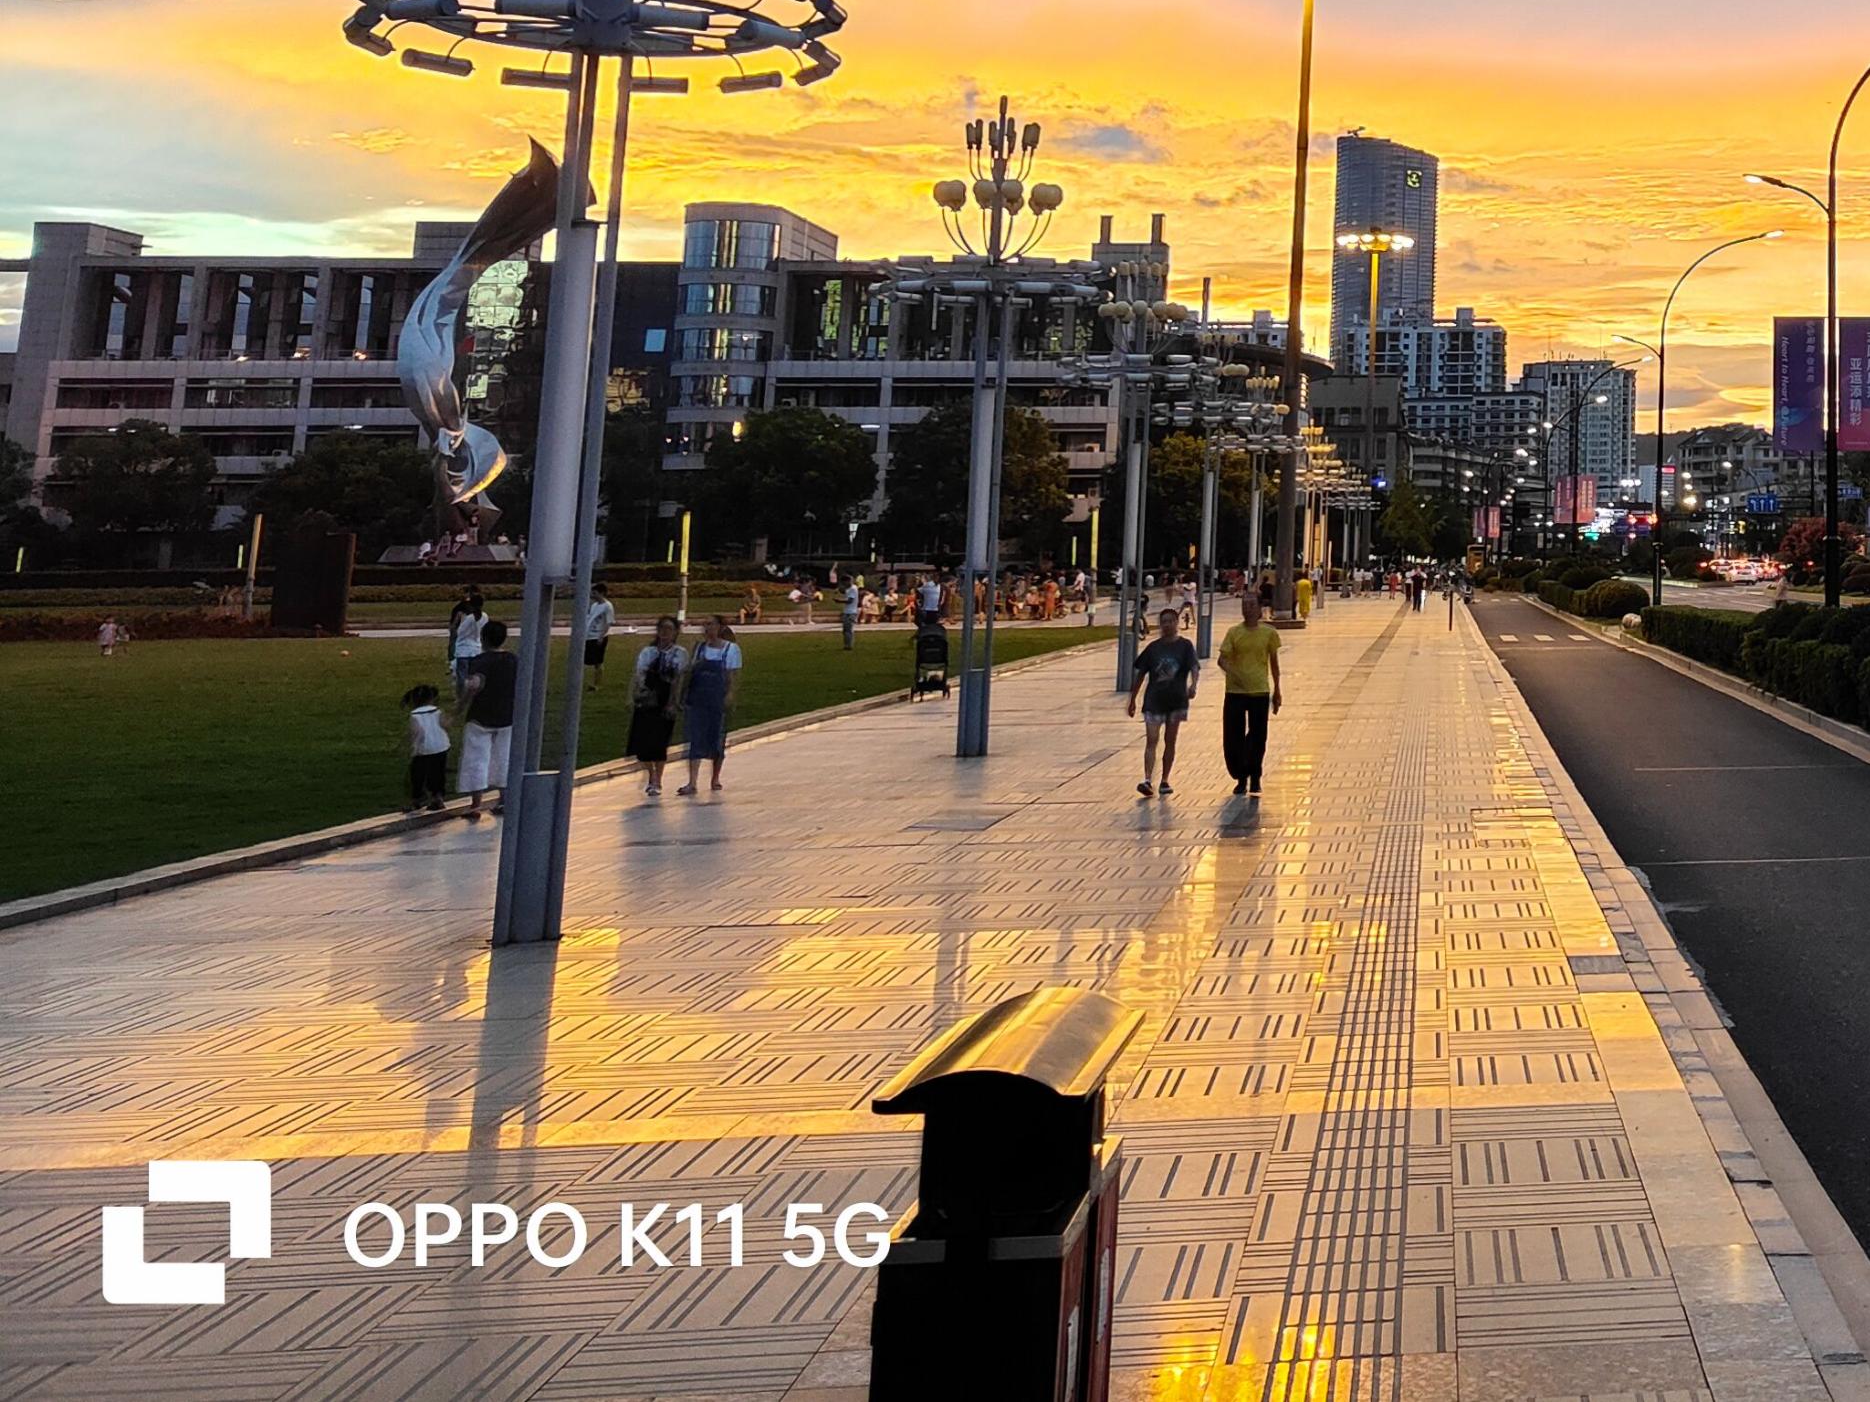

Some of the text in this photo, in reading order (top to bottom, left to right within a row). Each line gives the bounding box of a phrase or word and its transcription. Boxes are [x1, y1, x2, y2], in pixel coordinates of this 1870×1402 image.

[1849, 357, 1863, 426] 亚运添精彩
